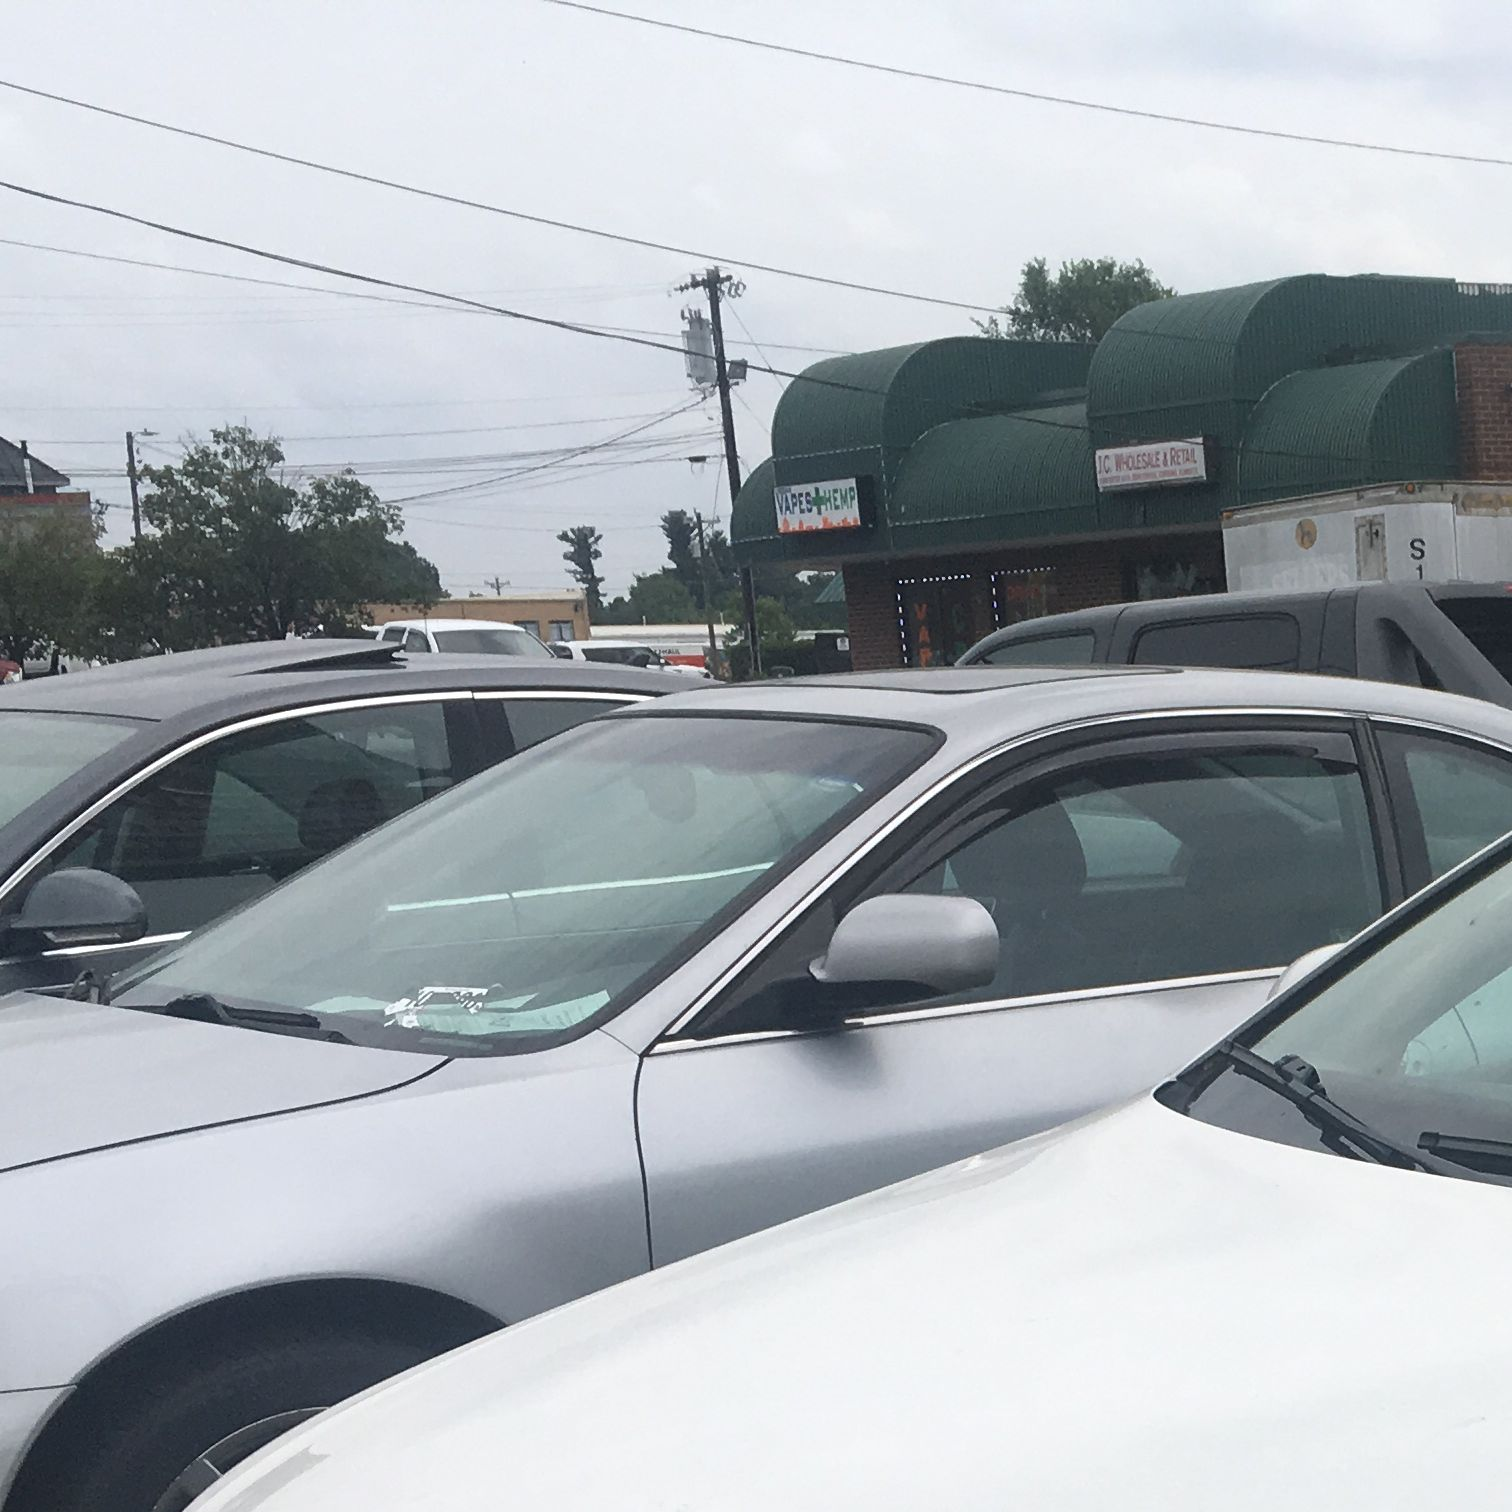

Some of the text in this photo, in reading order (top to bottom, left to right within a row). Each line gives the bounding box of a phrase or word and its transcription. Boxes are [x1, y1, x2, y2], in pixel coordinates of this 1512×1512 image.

[1170, 447, 1197, 467] RETAIL
[775, 486, 856, 515] VAPES HEMP
[1410, 538, 1426, 560] S
